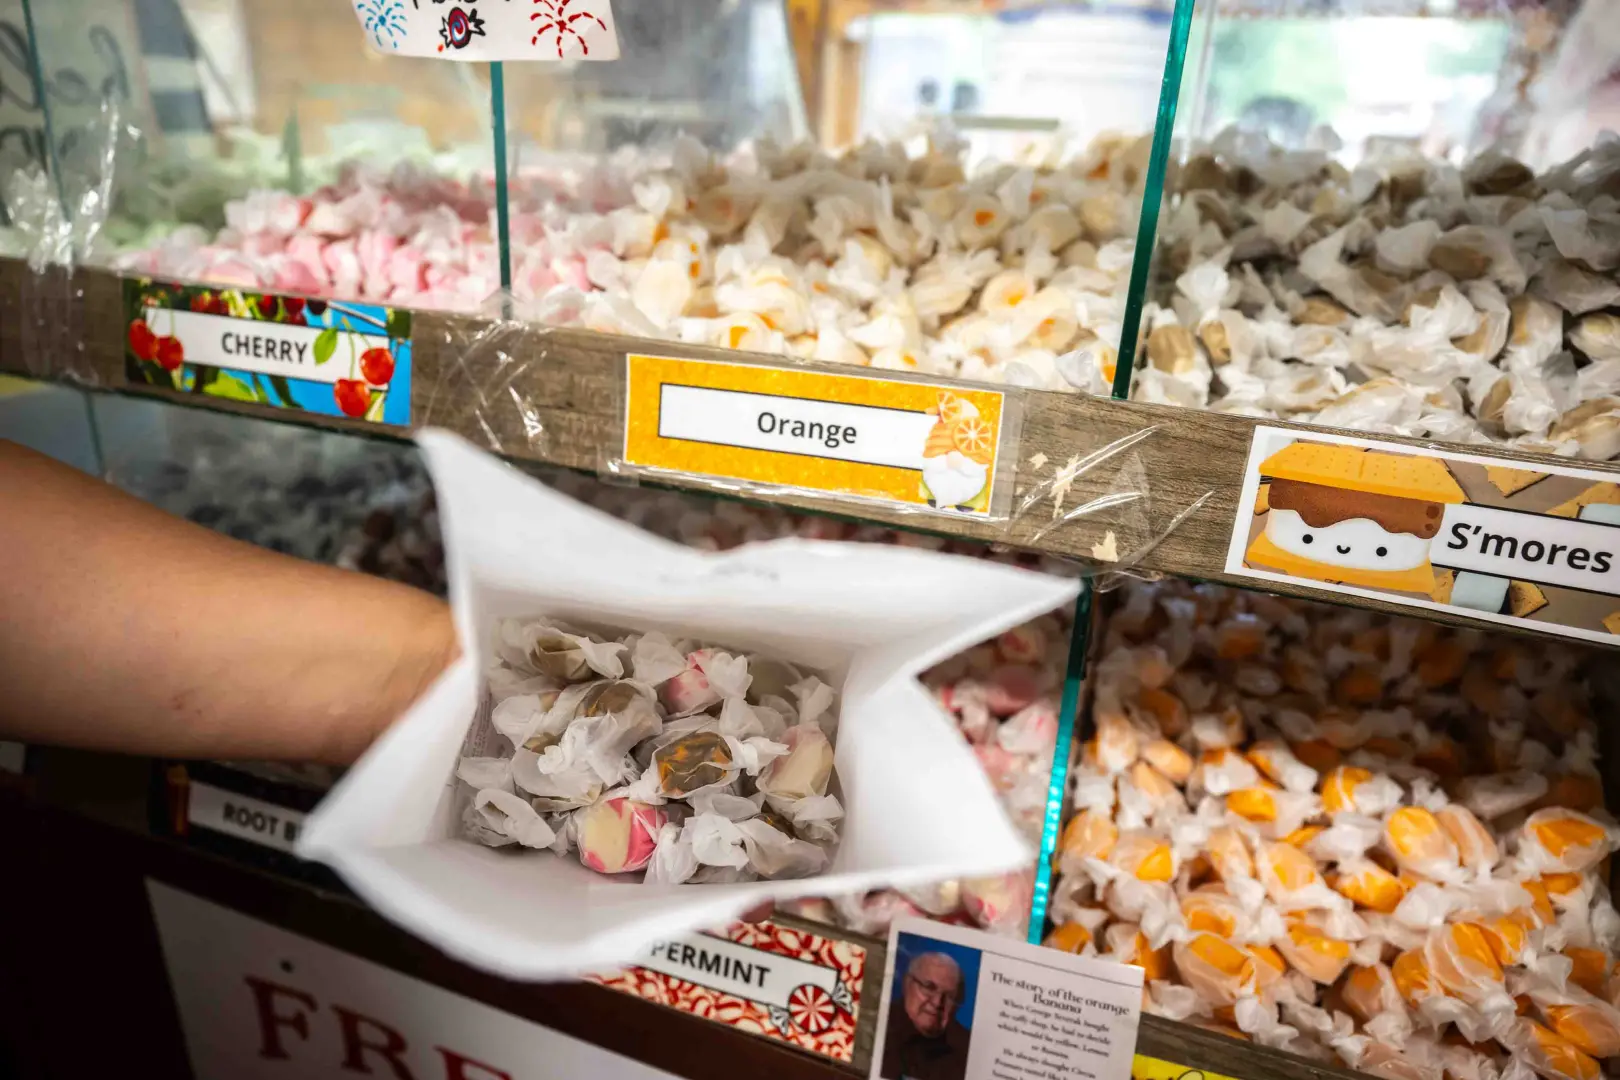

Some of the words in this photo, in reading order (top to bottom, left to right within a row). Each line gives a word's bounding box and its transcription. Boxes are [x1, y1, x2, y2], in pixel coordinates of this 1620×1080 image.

[222, 332, 307, 364] CHERRY
[757, 411, 858, 448] Orange
[1447, 522, 1613, 574] S'mores
[223, 802, 279, 836] ROOT
[650, 940, 771, 988] PERMINT
[990, 971, 1013, 986] The
[1015, 979, 1044, 995] story
[1048, 987, 1062, 998] of
[1062, 988, 1083, 1004] the
[1085, 996, 1130, 1016] orange
[1033, 993, 1082, 1014] Banana
